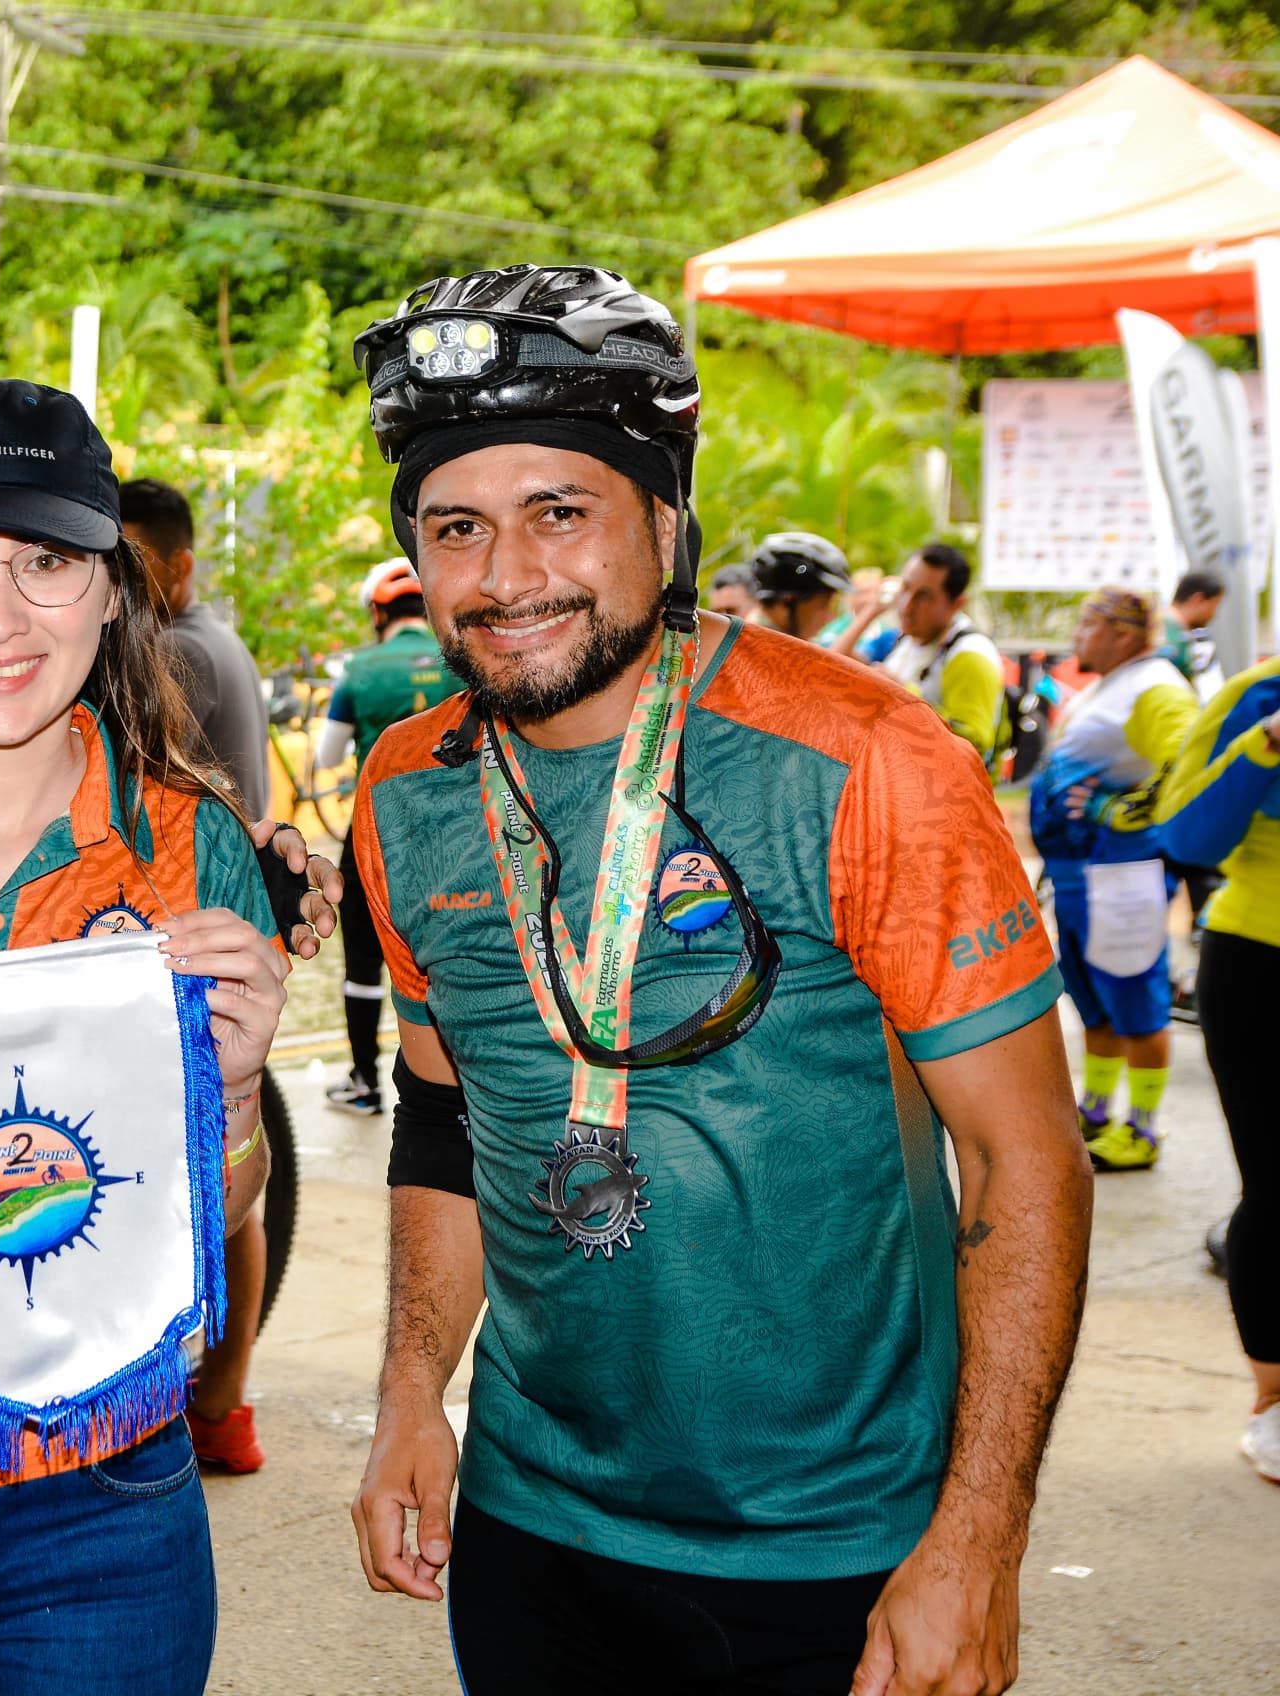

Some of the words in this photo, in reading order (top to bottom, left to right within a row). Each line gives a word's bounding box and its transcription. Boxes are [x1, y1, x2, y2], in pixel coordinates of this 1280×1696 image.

[633, 702, 664, 774] Análisis
[502, 824, 537, 853] 2
[946, 897, 1037, 970] 2K22
[595, 937, 614, 1007] Farmacias
[607, 950, 622, 1001] Ahorro
[14, 1064, 25, 1078] N
[7, 1132, 34, 1167] 2
[135, 1171, 145, 1184] E
[576, 1231, 601, 1243] POINT
[609, 1216, 629, 1239] POINT
[26, 1297, 34, 1311] S
